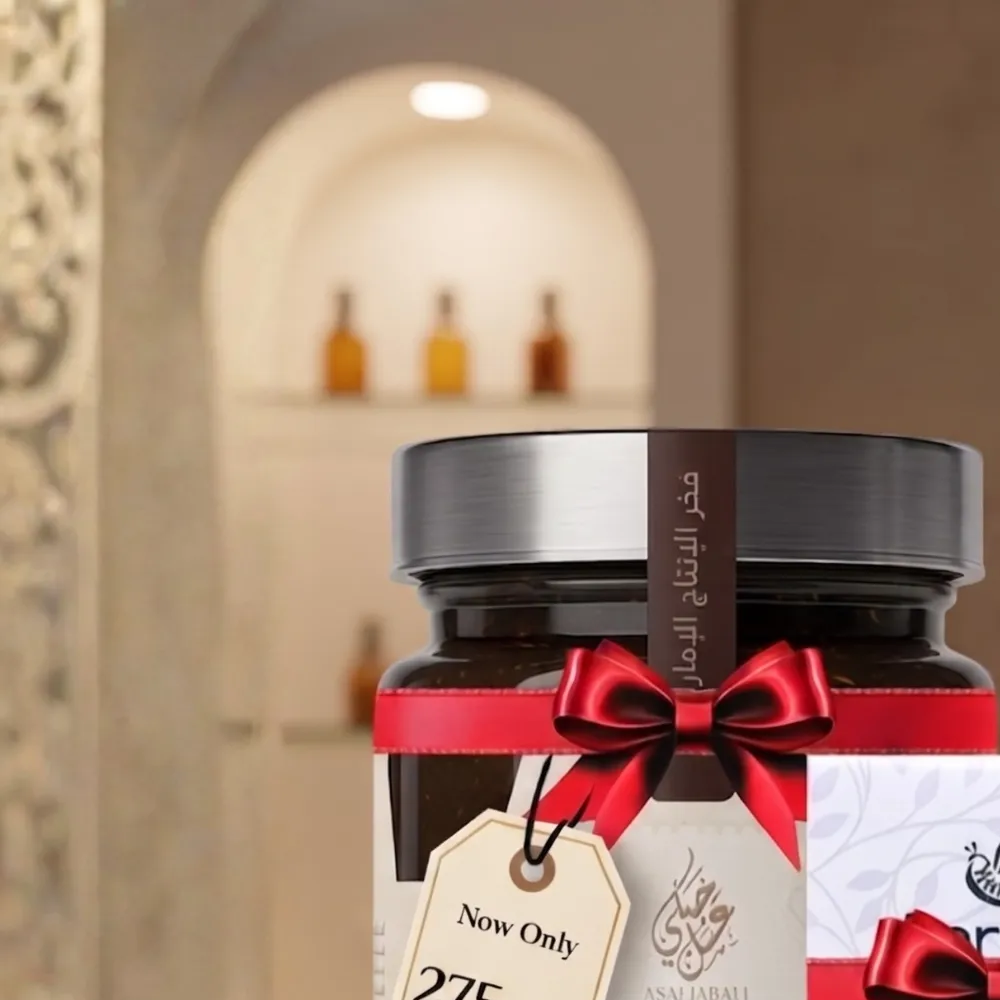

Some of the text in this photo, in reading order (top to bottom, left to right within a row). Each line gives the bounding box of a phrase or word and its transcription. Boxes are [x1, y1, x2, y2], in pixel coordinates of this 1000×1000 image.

[672, 617, 706, 687] الإمار
[457, 903, 579, 960] Now Only
